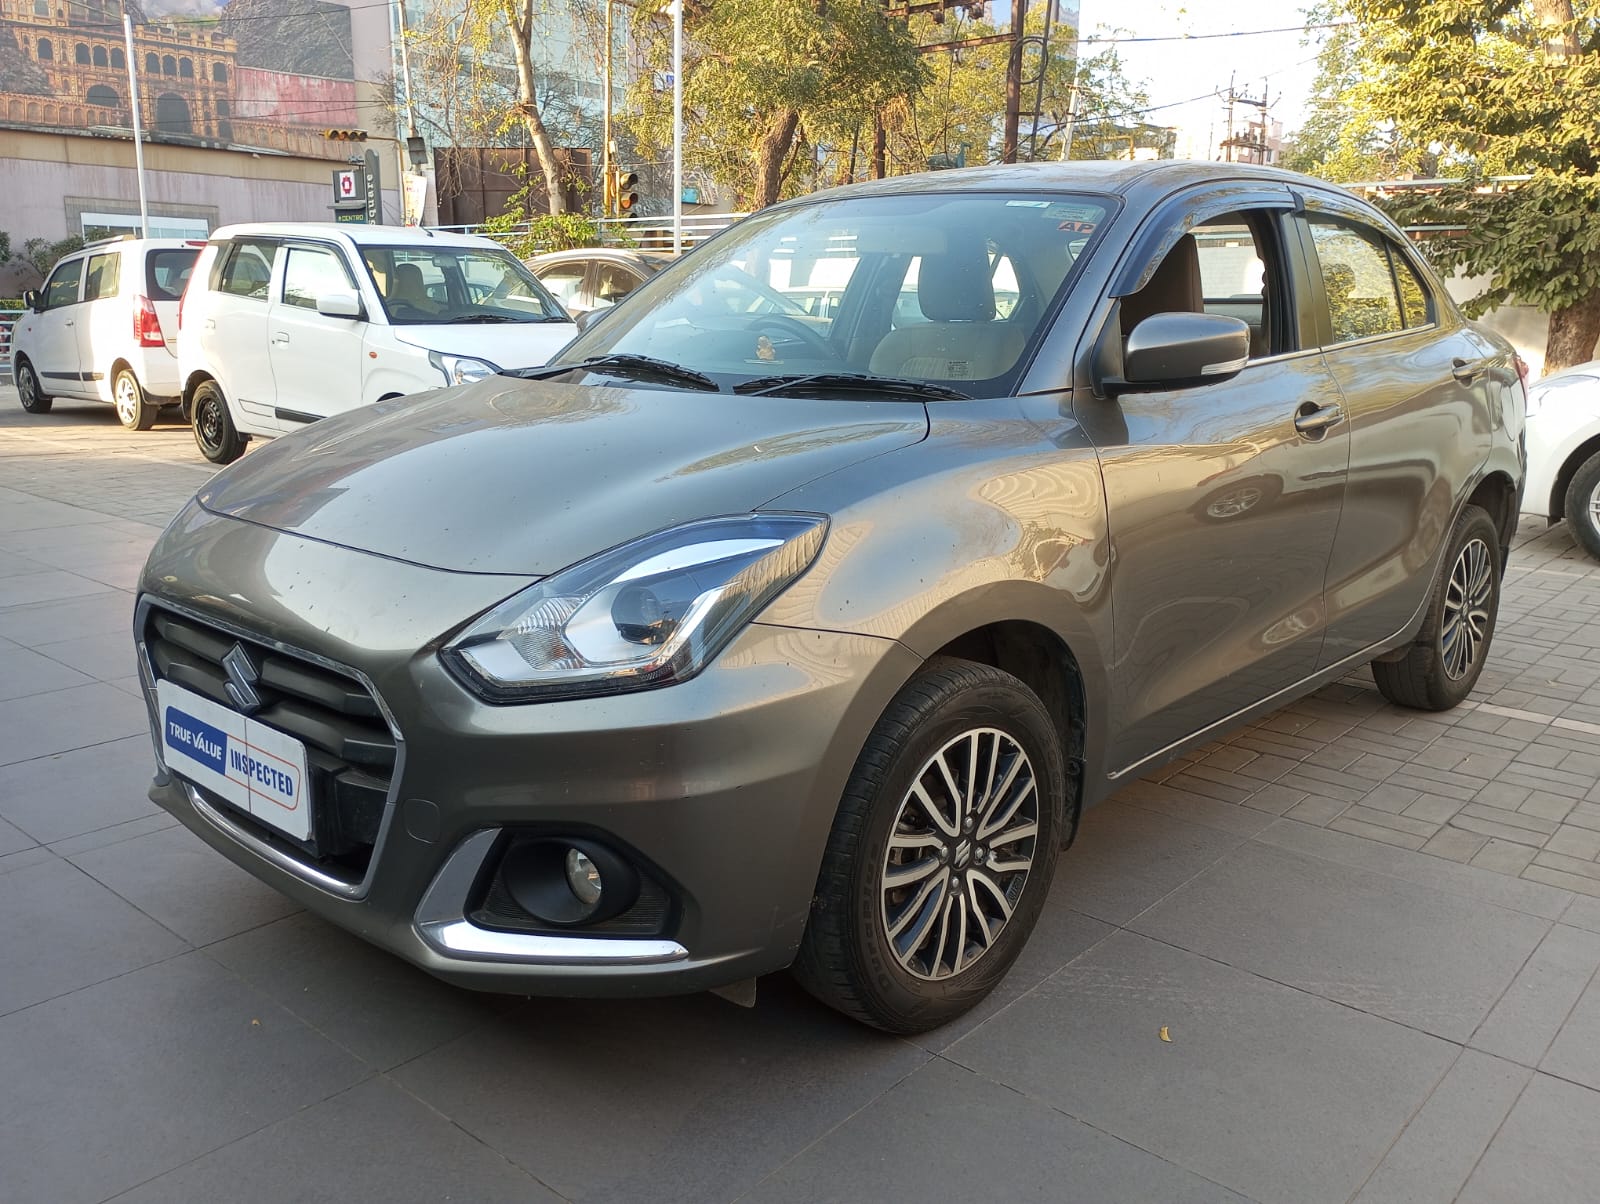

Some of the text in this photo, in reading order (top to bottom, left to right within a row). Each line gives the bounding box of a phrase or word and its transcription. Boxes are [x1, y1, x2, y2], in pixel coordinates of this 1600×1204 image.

[1058, 221, 1095, 232] AP
[169, 721, 293, 797] TRUE VALUE INSPECTED
